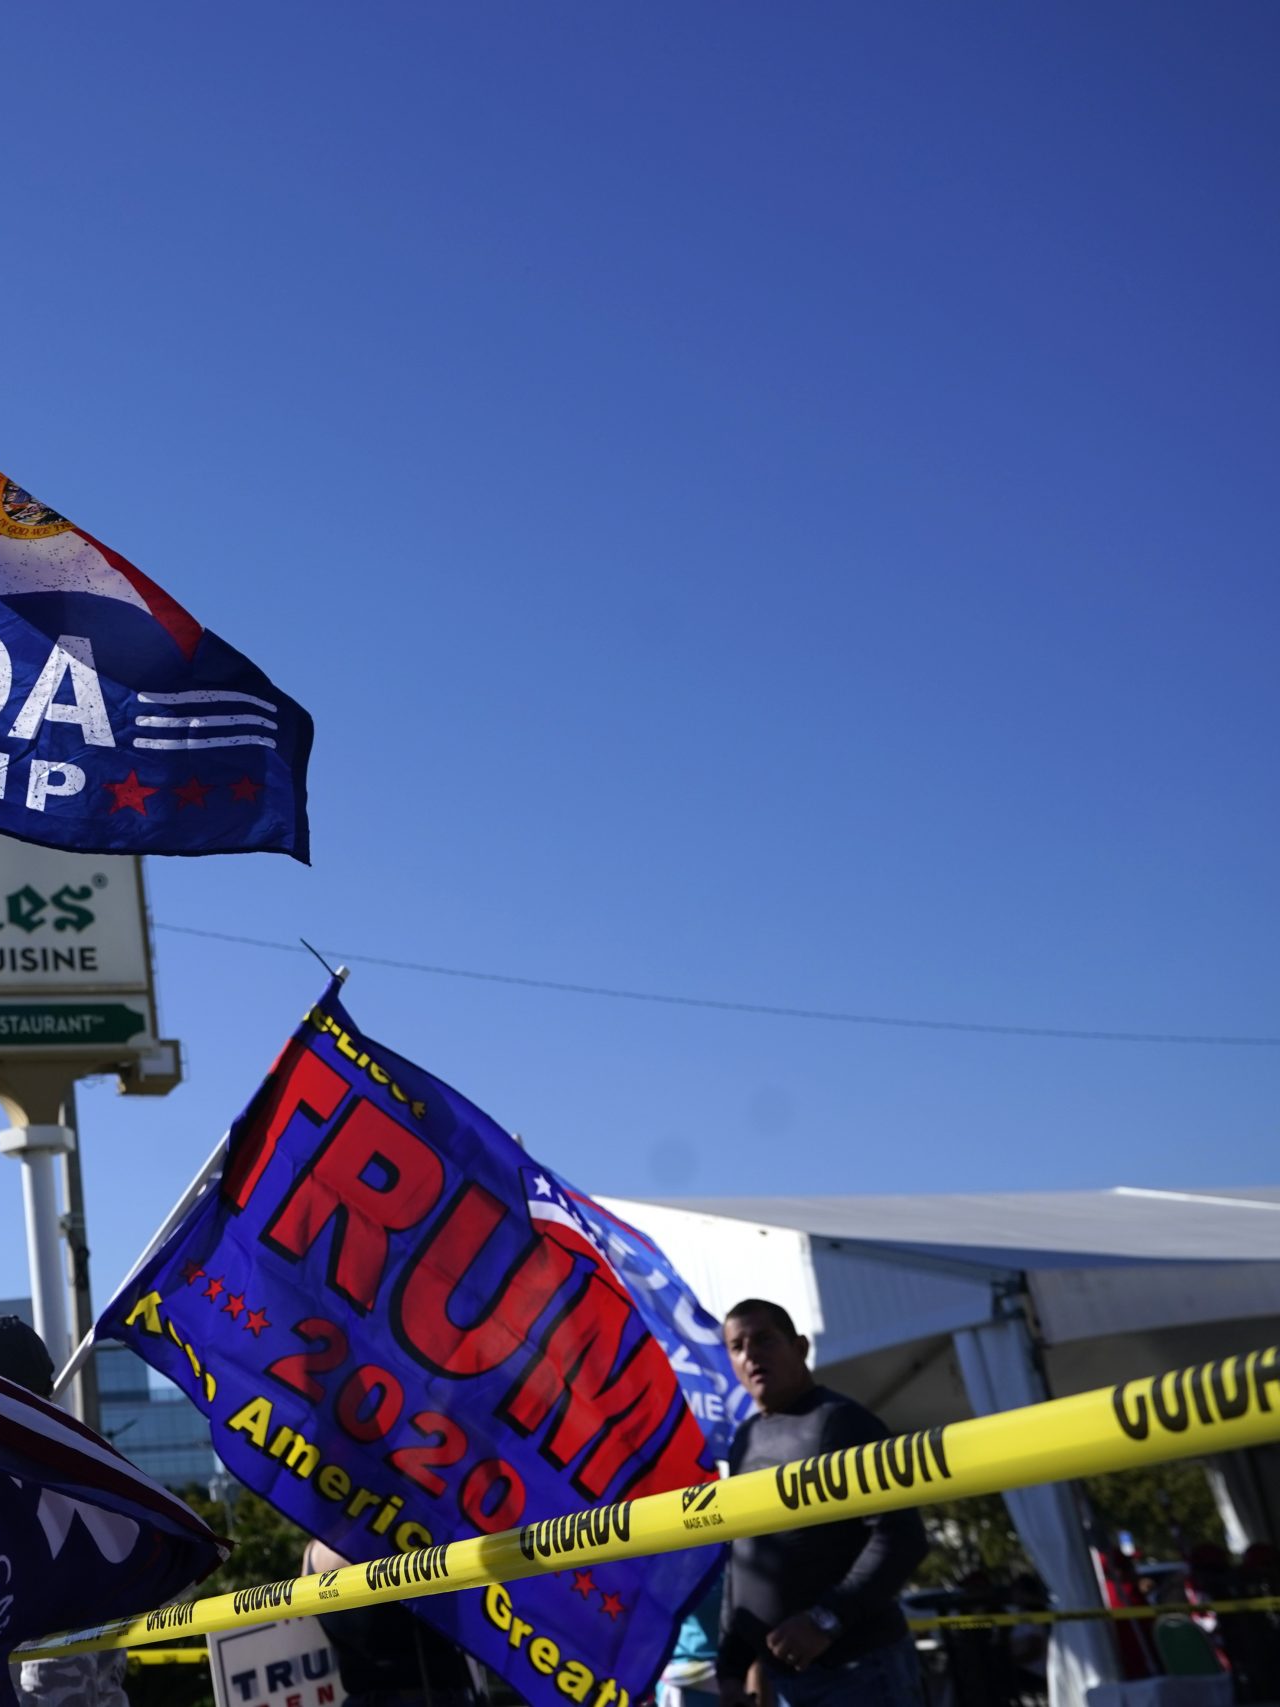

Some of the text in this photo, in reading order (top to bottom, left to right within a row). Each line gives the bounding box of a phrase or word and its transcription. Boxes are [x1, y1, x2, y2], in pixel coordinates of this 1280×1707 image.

[228, 1396, 432, 1552] Americ
[263, 1318, 526, 1538] 2020
[147, 1602, 193, 1631] CAUTION
[233, 1578, 297, 1615] CUIDADO
[366, 1544, 449, 1591] CAUTION
[521, 1500, 633, 1560] CUIDADO
[776, 1426, 951, 1510] CAUTION
[231, 1648, 331, 1701] TRU
